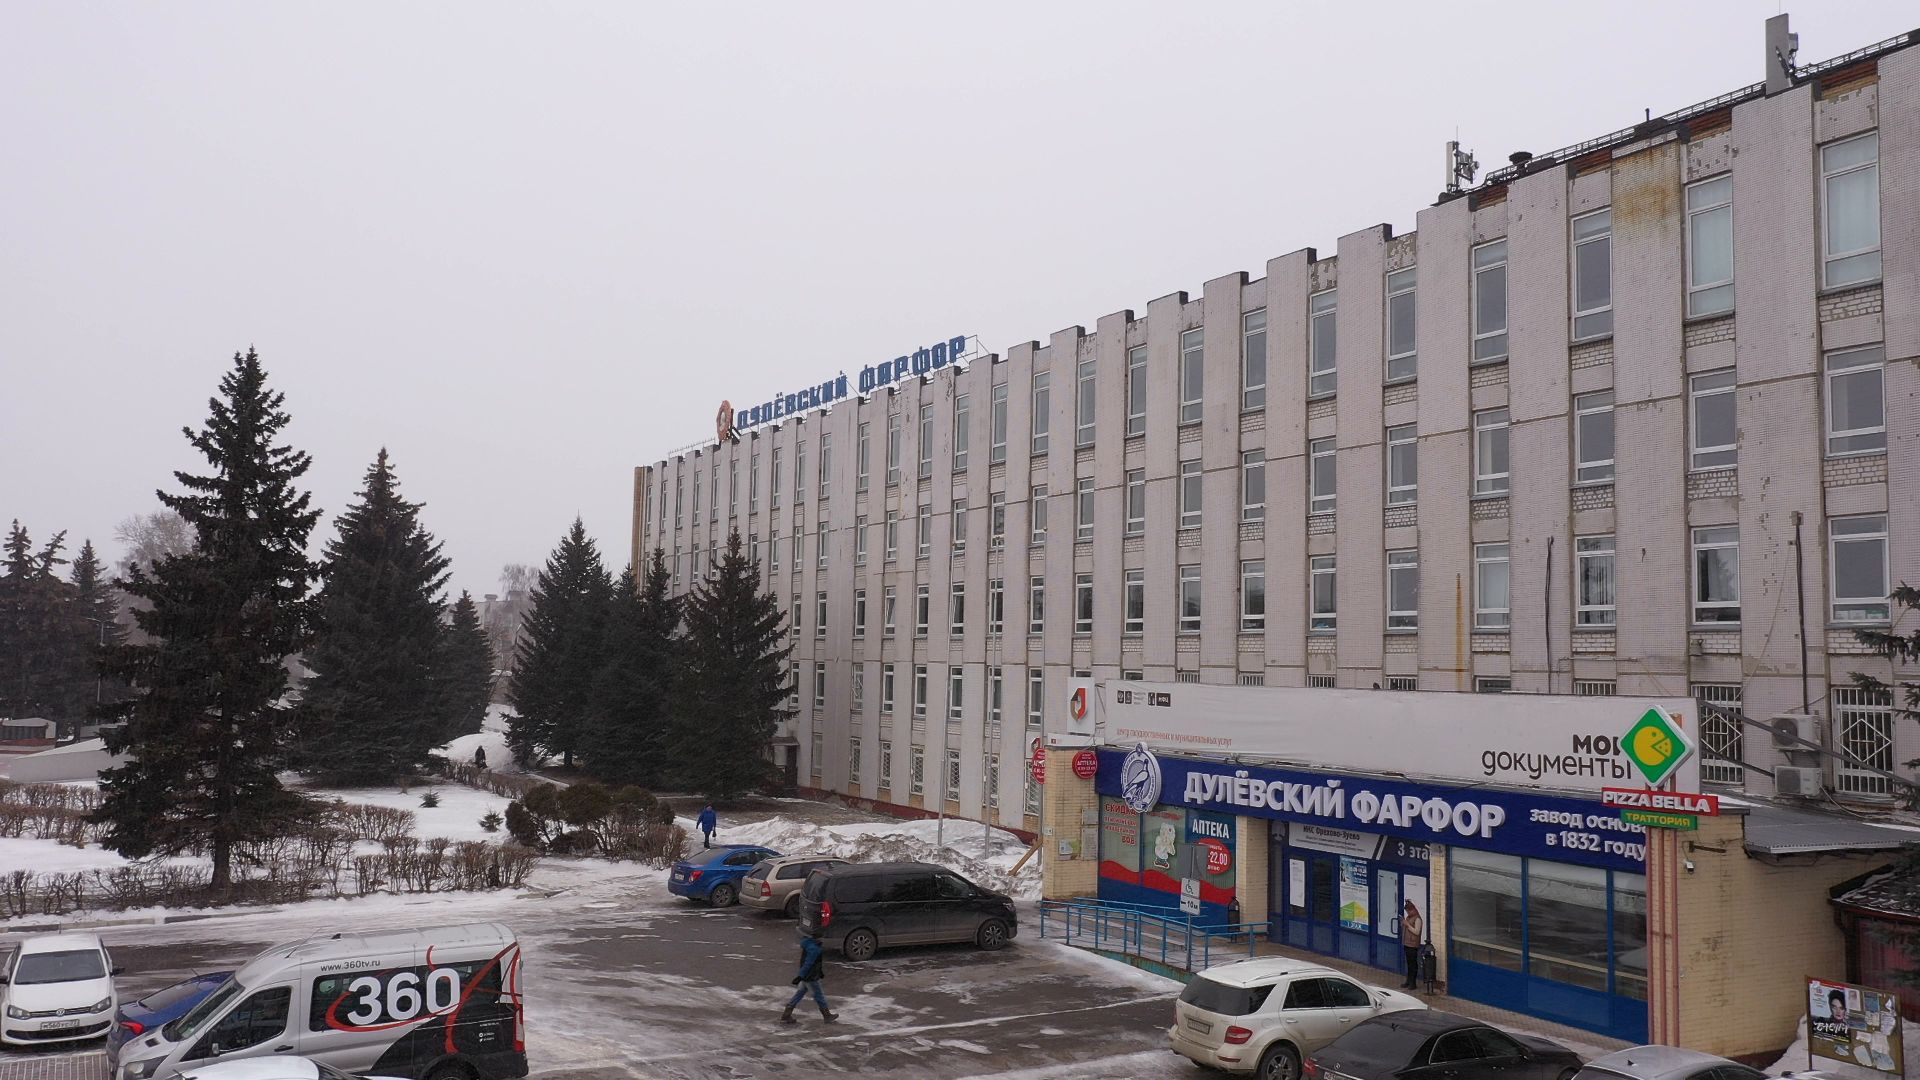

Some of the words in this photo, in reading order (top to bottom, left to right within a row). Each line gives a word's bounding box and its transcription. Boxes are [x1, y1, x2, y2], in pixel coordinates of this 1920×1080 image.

[859, 335, 966, 393] ФАРФОР
[1481, 750, 1632, 780] документы
[1184, 770, 1345, 819] ДУЛЁВСКИЙ
[1351, 790, 1505, 838] ФАРФОР
[1602, 791, 1651, 808] PIZZA
[1652, 795, 1711, 813] BELLA
[1192, 818, 1230, 839] АПТЕКА
[1530, 808, 1584, 829] завод
[1625, 812, 1690, 827] ТРАТТОРИЯ
[1397, 842, 1405, 857] 3
[1409, 846, 1431, 860] эта
[1546, 833, 1557, 845] в
[1560, 830, 1601, 851] 1832
[1604, 840, 1647, 862] году
[320, 960, 381, 972] www.360tv.ru
[347, 967, 461, 1025] 360
